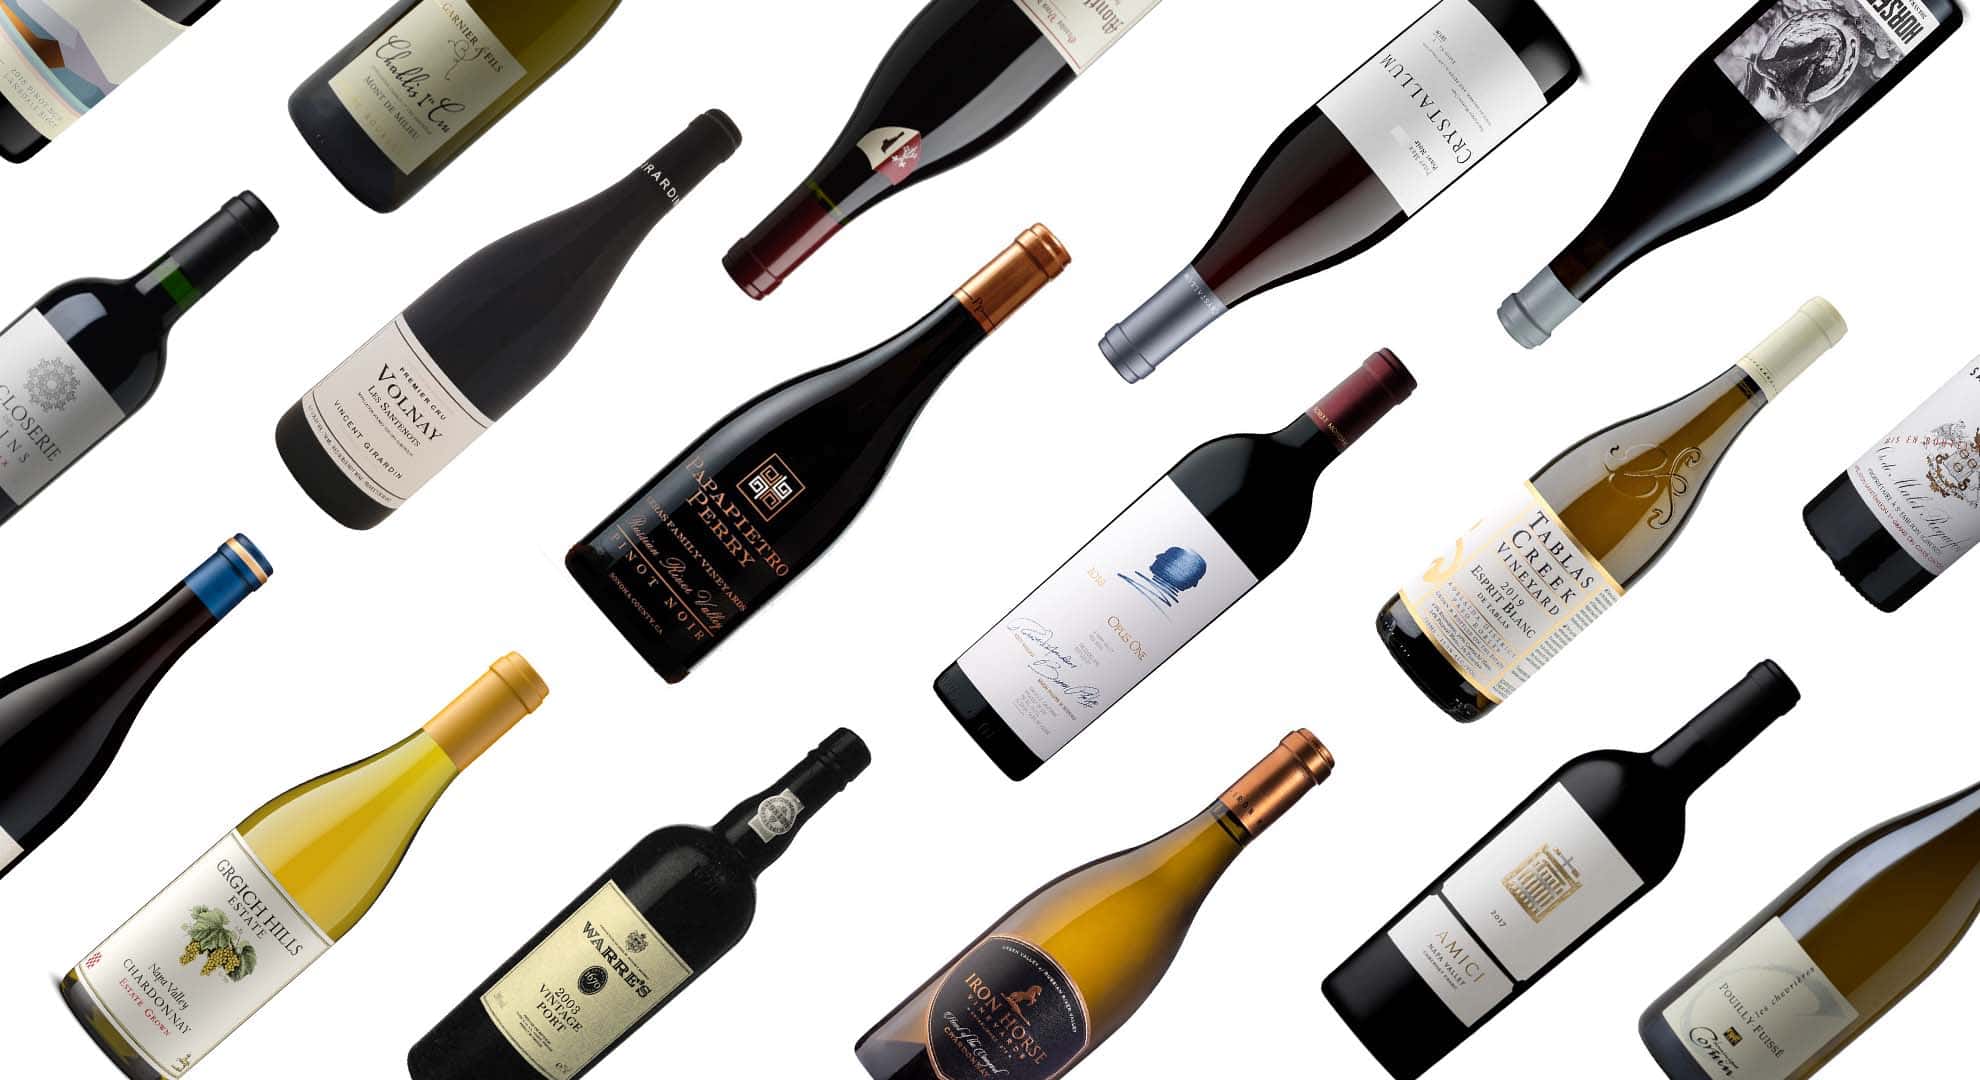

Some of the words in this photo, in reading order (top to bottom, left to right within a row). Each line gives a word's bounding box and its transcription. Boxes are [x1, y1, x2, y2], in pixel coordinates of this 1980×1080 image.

[440, 2, 478, 46] GARNIER
[482, 50, 504, 73] FILS
[1082, 0, 1124, 37] Mont
[1866, 0, 1925, 44] HORSE
[375, 35, 431, 98] Chablis
[1380, 53, 1472, 164] CRYSTALLUM
[378, 363, 443, 440] VOLNAY
[398, 366, 431, 404] PREMIER
[429, 403, 447, 422] CRU
[334, 399, 364, 439] VINCENT
[362, 442, 402, 480] GIRARDIN
[685, 456, 789, 577] PAPAPIETRO
[685, 487, 756, 567] PERRY
[666, 520, 701, 559] FAMILY
[699, 558, 748, 614] VINEYARDS
[1512, 529, 1577, 604] CREEK
[1528, 510, 1594, 588] TABLAS
[607, 570, 633, 601] SONOMA
[611, 533, 660, 588] PINOT
[663, 596, 705, 641] NOIR
[1470, 564, 1505, 603] ESPRIT
[1501, 601, 1536, 639] BLANC
[1497, 540, 1560, 616] VINEYARD
[1500, 581, 1525, 607] 2019
[694, 589, 726, 630] Valley
[1476, 591, 1486, 603] DE
[1485, 603, 1509, 629] TABLAS
[1107, 615, 1129, 643] OPUS
[1129, 640, 1147, 661] ONE
[216, 859, 268, 918] GRGICH
[263, 914, 303, 956] HILLS
[227, 895, 265, 938] ESTATE
[1488, 909, 1507, 929] 2017
[583, 921, 651, 998] WARRE'S
[585, 971, 602, 990] 1670
[1020, 951, 1039, 967] VALLEY
[1041, 970, 1063, 994] RUSSIAN
[1428, 942, 1445, 962] NAPA
[1442, 961, 1466, 987] VALLEY
[1435, 931, 1485, 983] AMICI
[119, 976, 145, 1008] ESTATE
[143, 1007, 169, 1038] GROWN
[123, 958, 192, 1034] CHARDONNAY
[148, 963, 169, 986] Napa
[167, 981, 189, 1011] Valley
[539, 983, 583, 1033] VINTAGE
[553, 987, 579, 1015] 2003
[1060, 993, 1074, 1011] RIVER
[536, 1001, 565, 1032] PORT
[964, 972, 1002, 1012] IRON
[999, 1012, 1047, 1065] HORSE
[967, 993, 1025, 1062] VINEYARDS
[1066, 1012, 1079, 1033] VALLEY
[1719, 982, 1785, 1057] POUILLY-FUISSÉ
